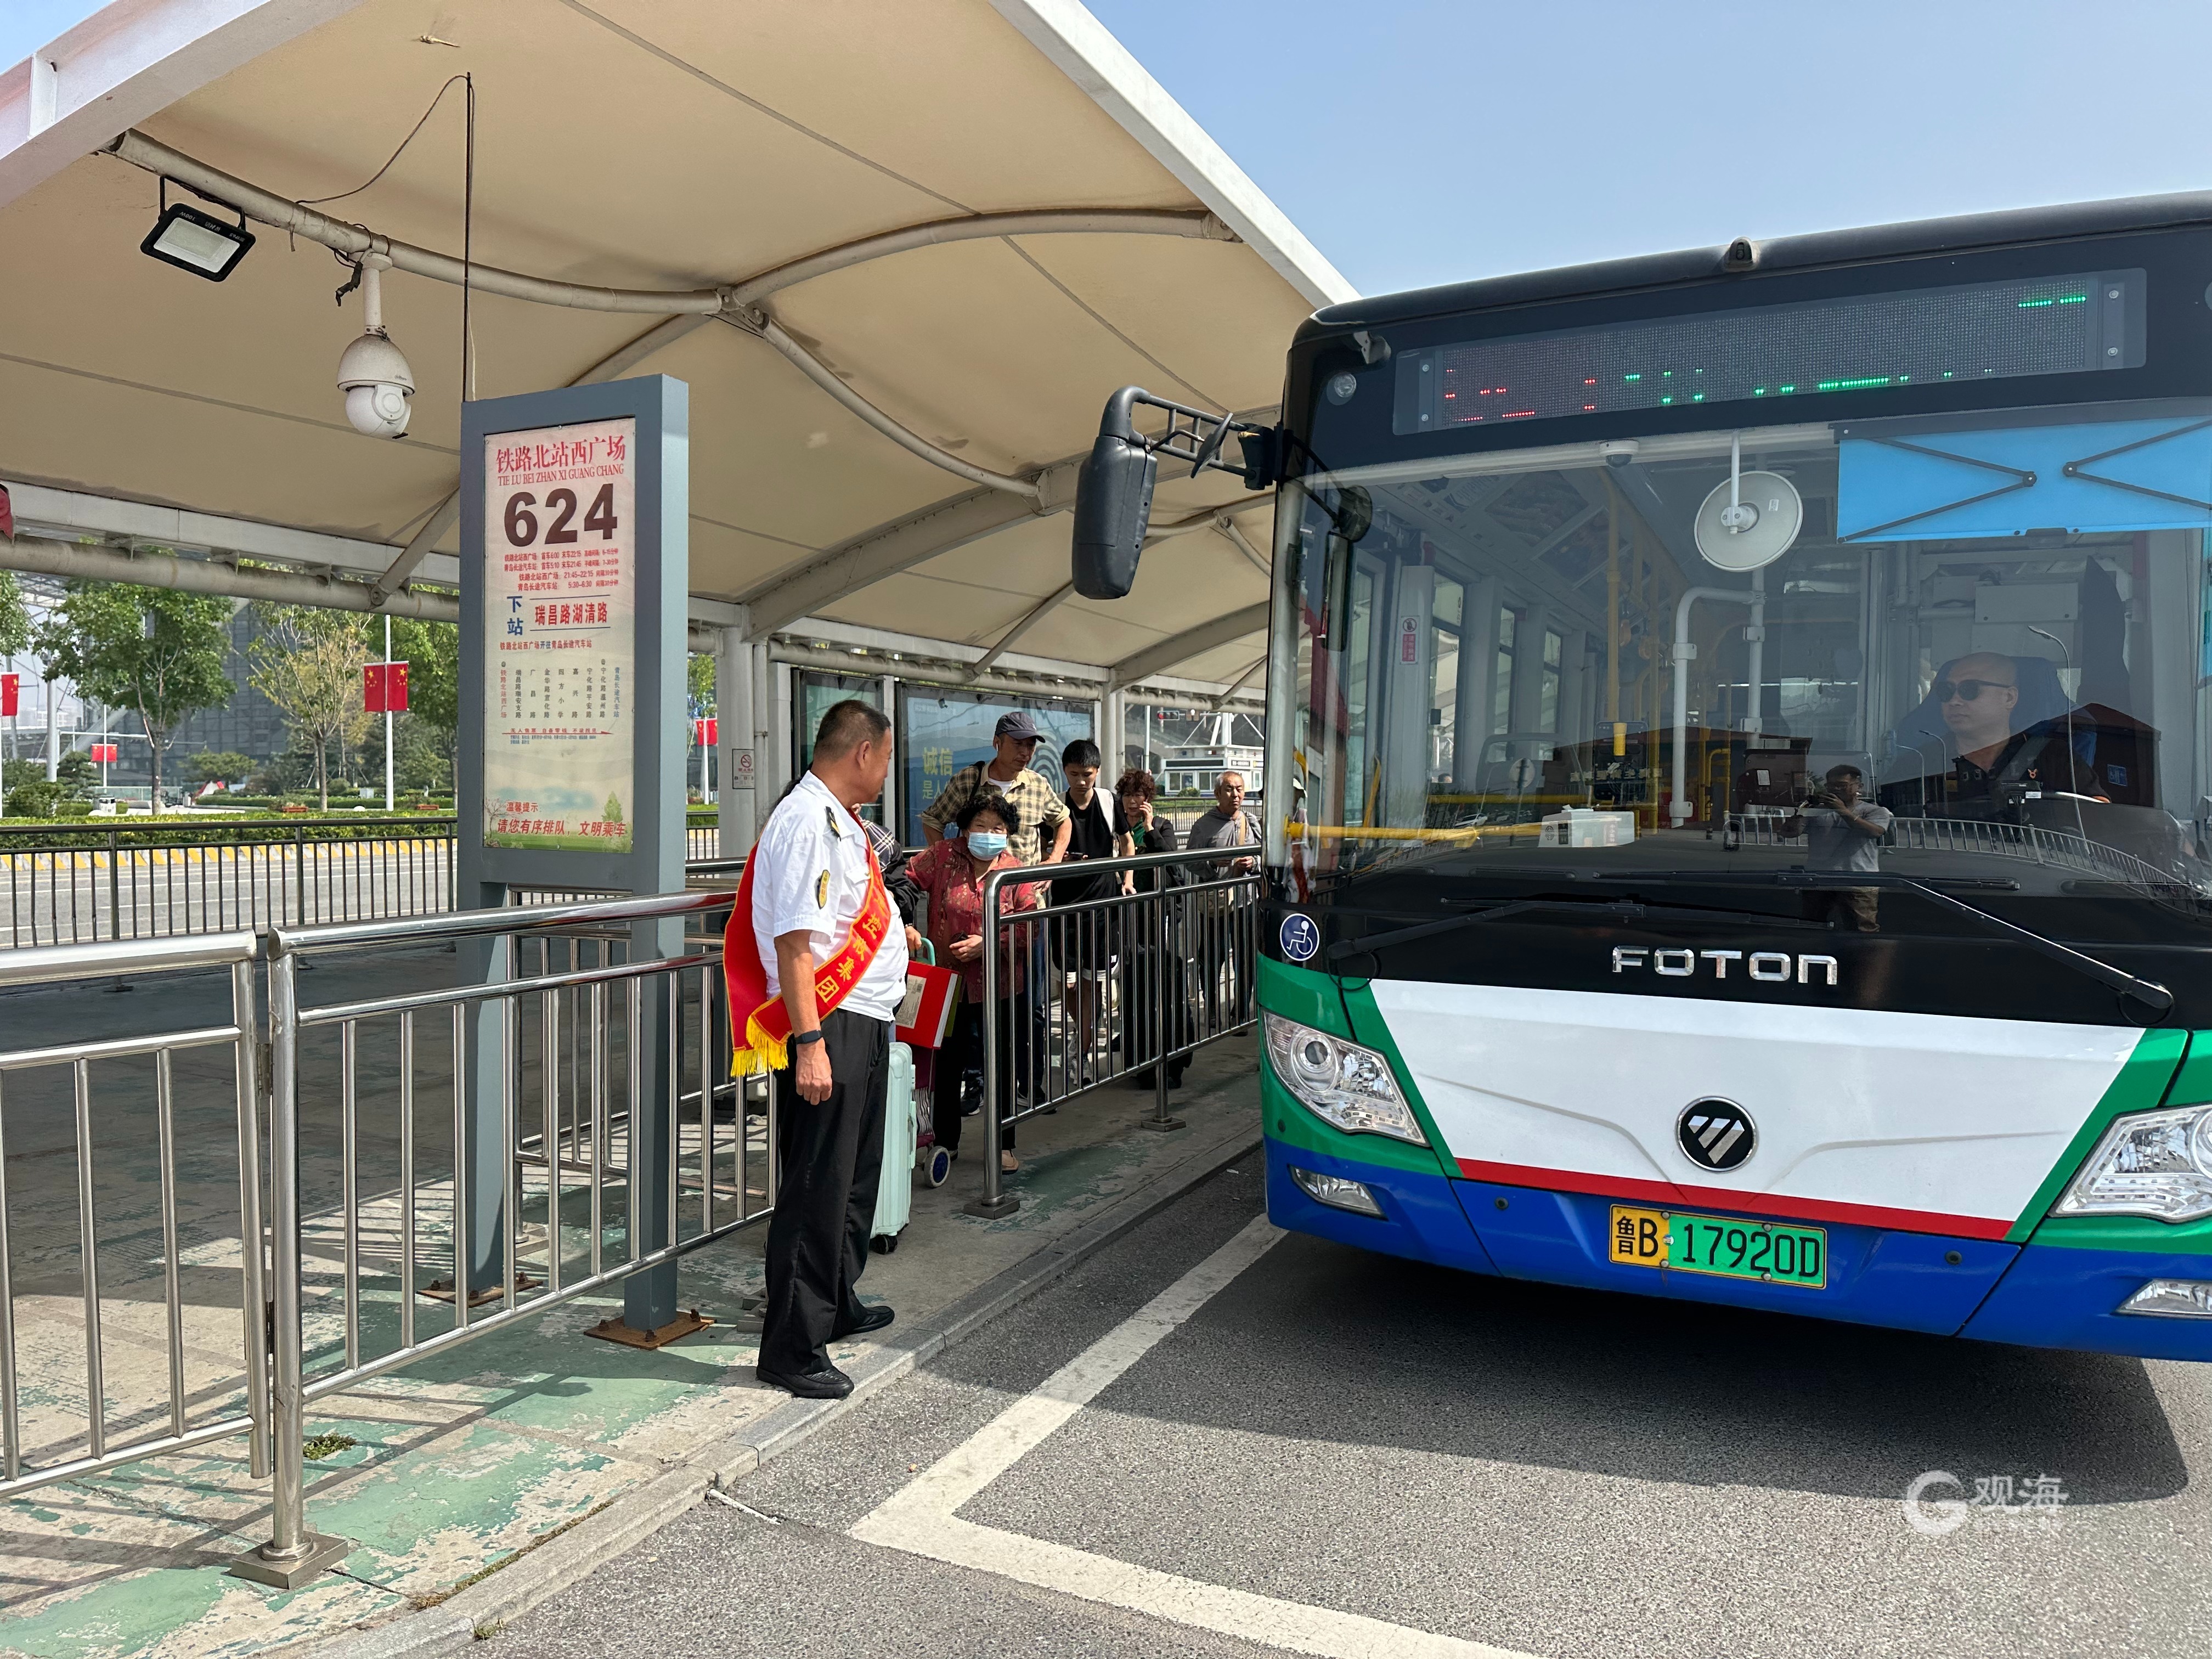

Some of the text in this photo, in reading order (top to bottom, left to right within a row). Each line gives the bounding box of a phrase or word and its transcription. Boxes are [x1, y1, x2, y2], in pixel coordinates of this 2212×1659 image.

[496, 435, 625, 473] 铁路北站西广场
[498, 464, 624, 486] TIE LU BEI ZHAN XI GUANG CHANG
[504, 483, 618, 547] 624
[507, 596, 523, 635] 下站
[535, 602, 607, 625] 瑞昌路湖清路
[500, 639, 592, 651] 铁路北站西广场开往青岛长途汽车站
[922, 746, 953, 776] 诚信
[922, 780, 949, 799] 是人
[1612, 945, 1837, 985] FOTON
